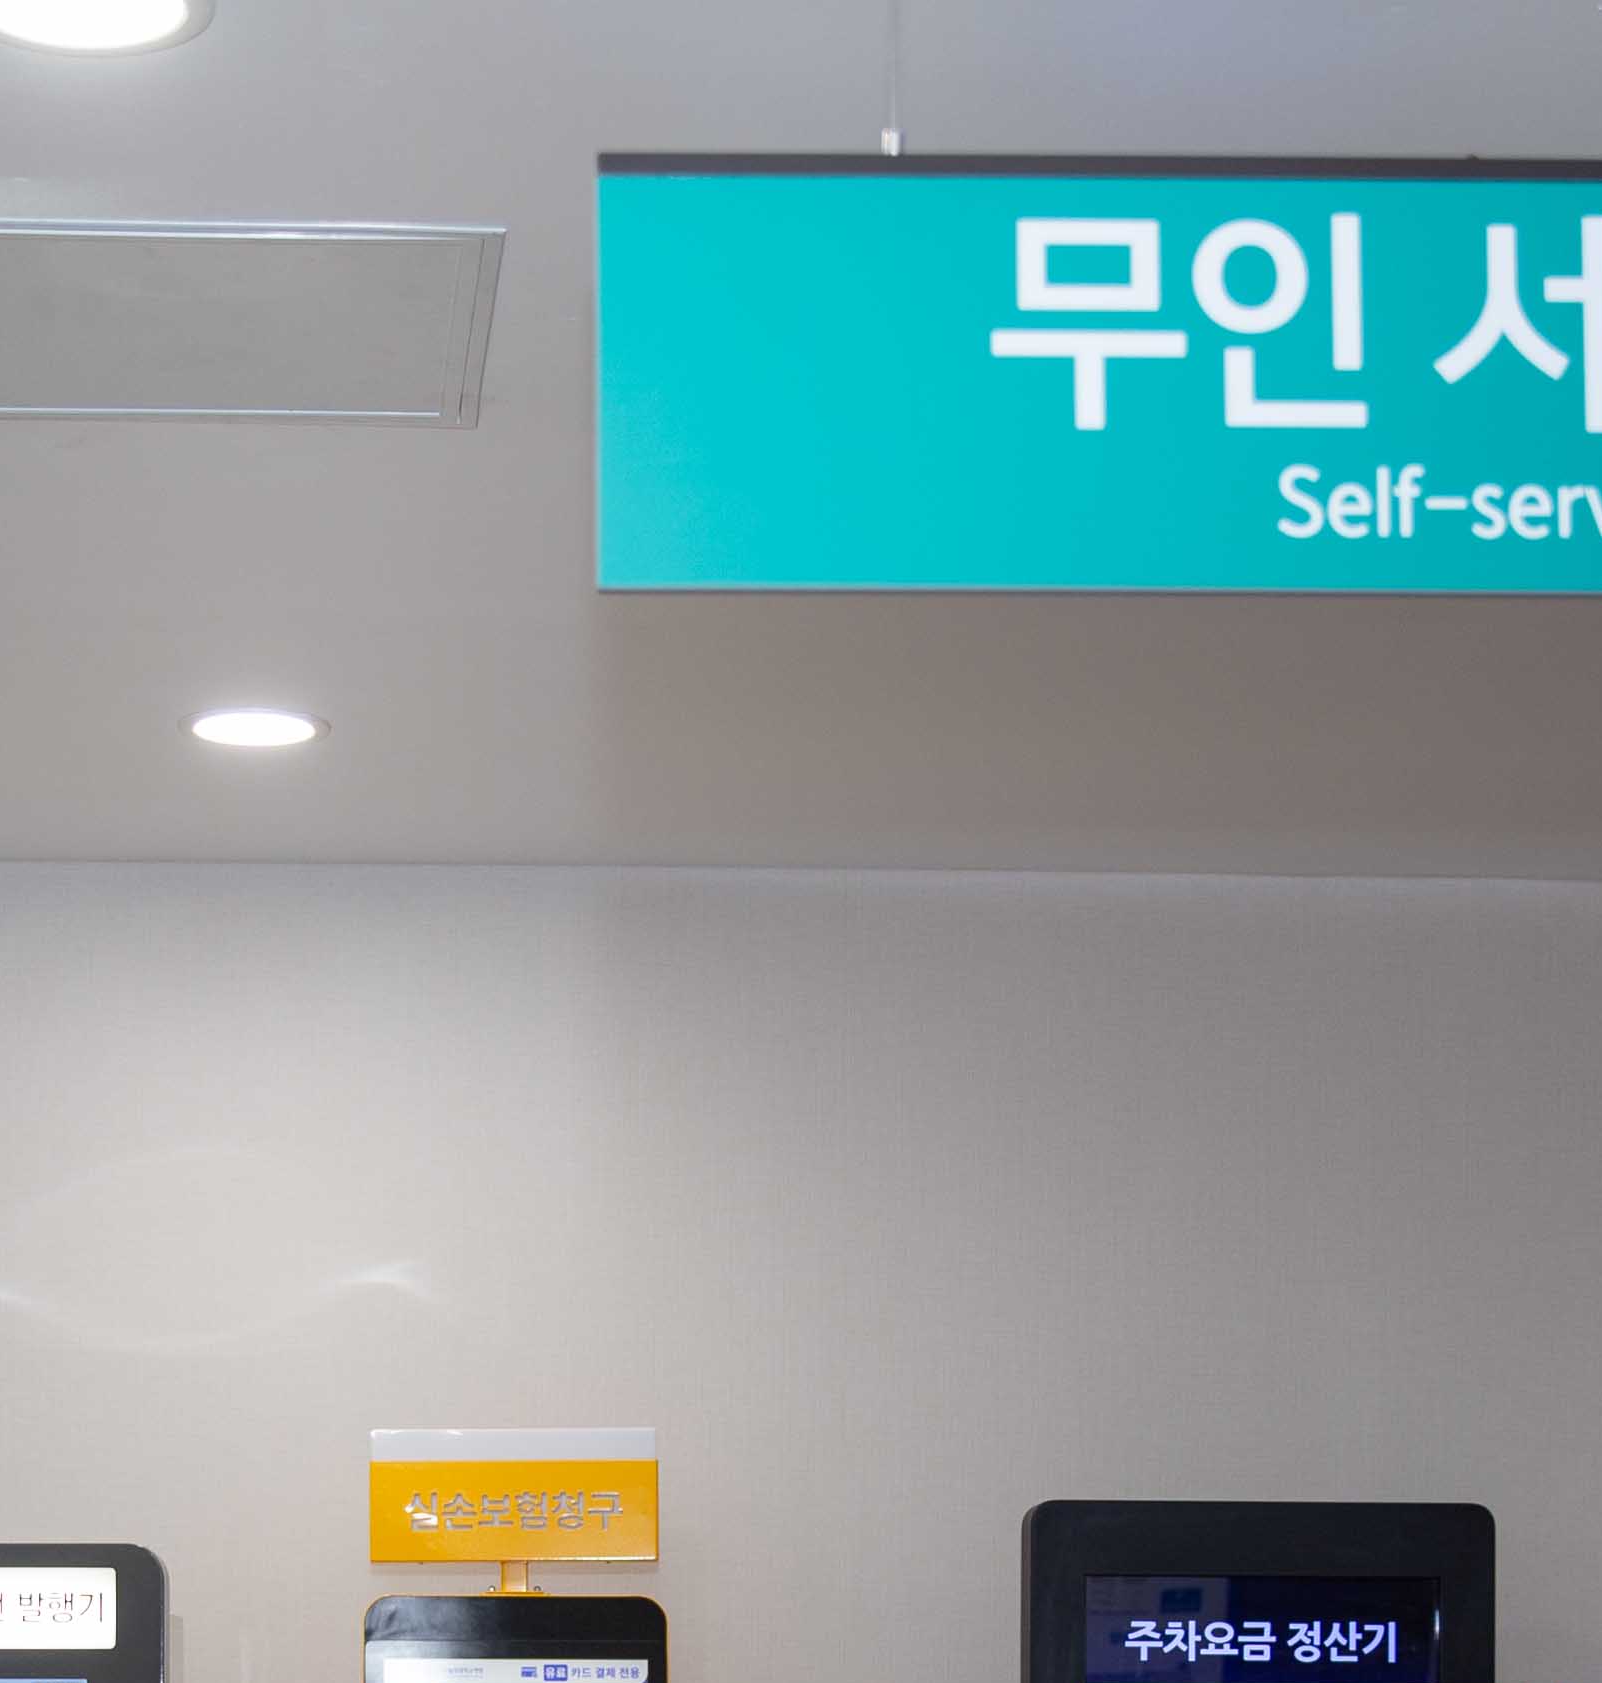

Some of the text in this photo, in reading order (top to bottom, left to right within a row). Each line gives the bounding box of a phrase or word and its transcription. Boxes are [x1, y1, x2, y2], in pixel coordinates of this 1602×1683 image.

[990, 210, 1370, 431] 무인
[404, 1491, 623, 1530] 실손보험청구
[19, 1593, 103, 1623] 발행기
[1125, 1620, 1397, 1664] 주차요금 정산기
[571, 1667, 640, 1678] 카드 결제 전용
